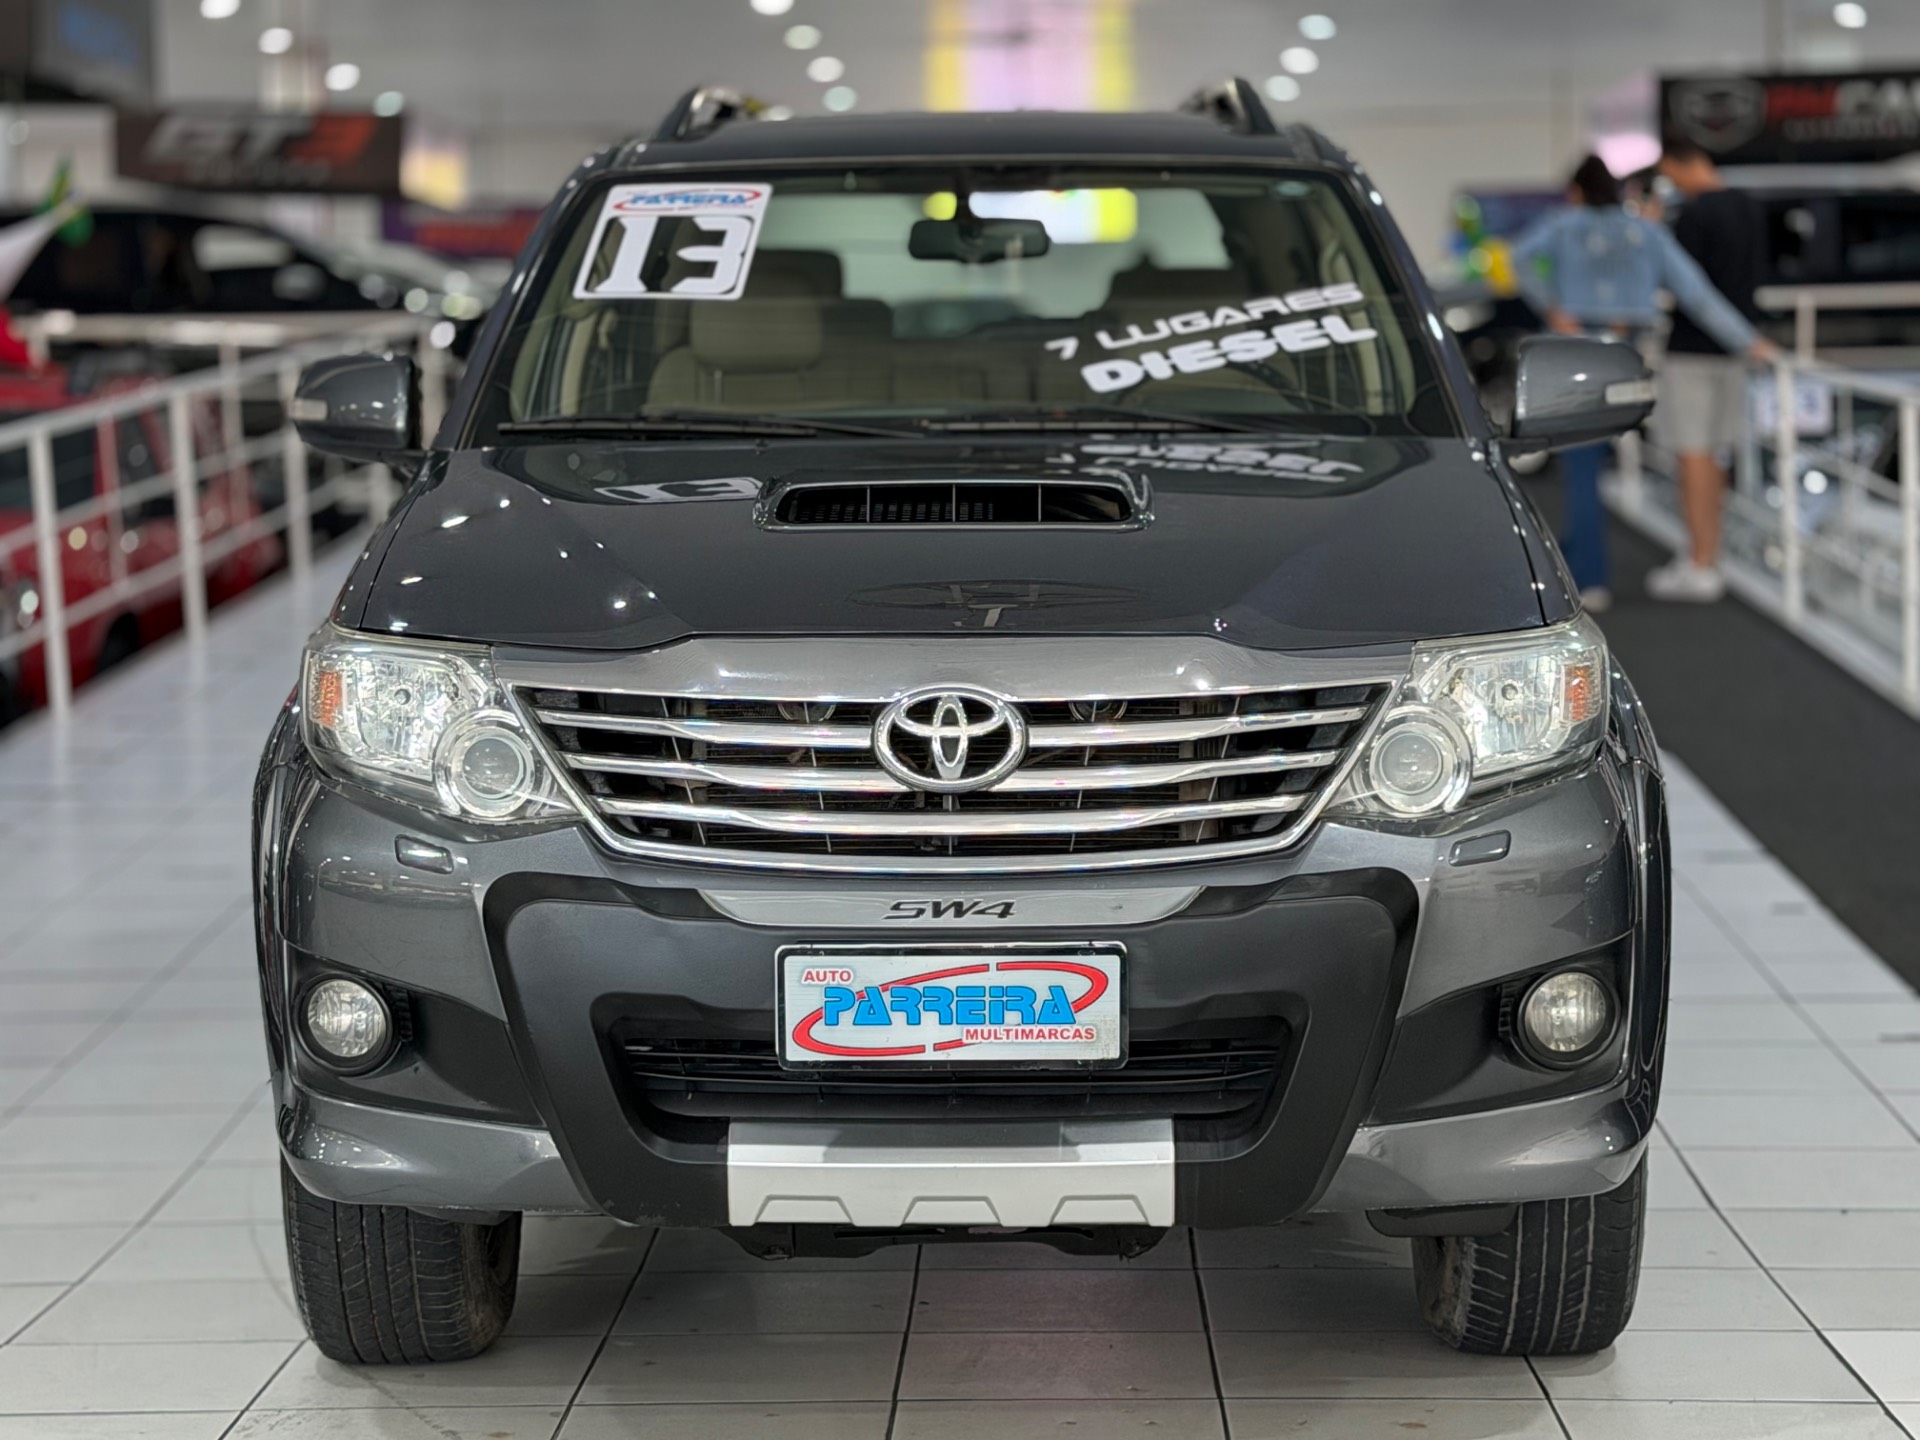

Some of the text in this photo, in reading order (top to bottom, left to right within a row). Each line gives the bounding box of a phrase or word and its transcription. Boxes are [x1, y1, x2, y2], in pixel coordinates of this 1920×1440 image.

[594, 216, 752, 293] 13
[1044, 281, 1365, 360] 7 LUGARES
[1080, 314, 1379, 393] DIESEL
[881, 899, 1016, 919] SW4
[803, 969, 852, 983] AUTO
[823, 985, 1077, 1026] PARREIRA
[964, 1027, 1097, 1042] MULTIMARCAS
